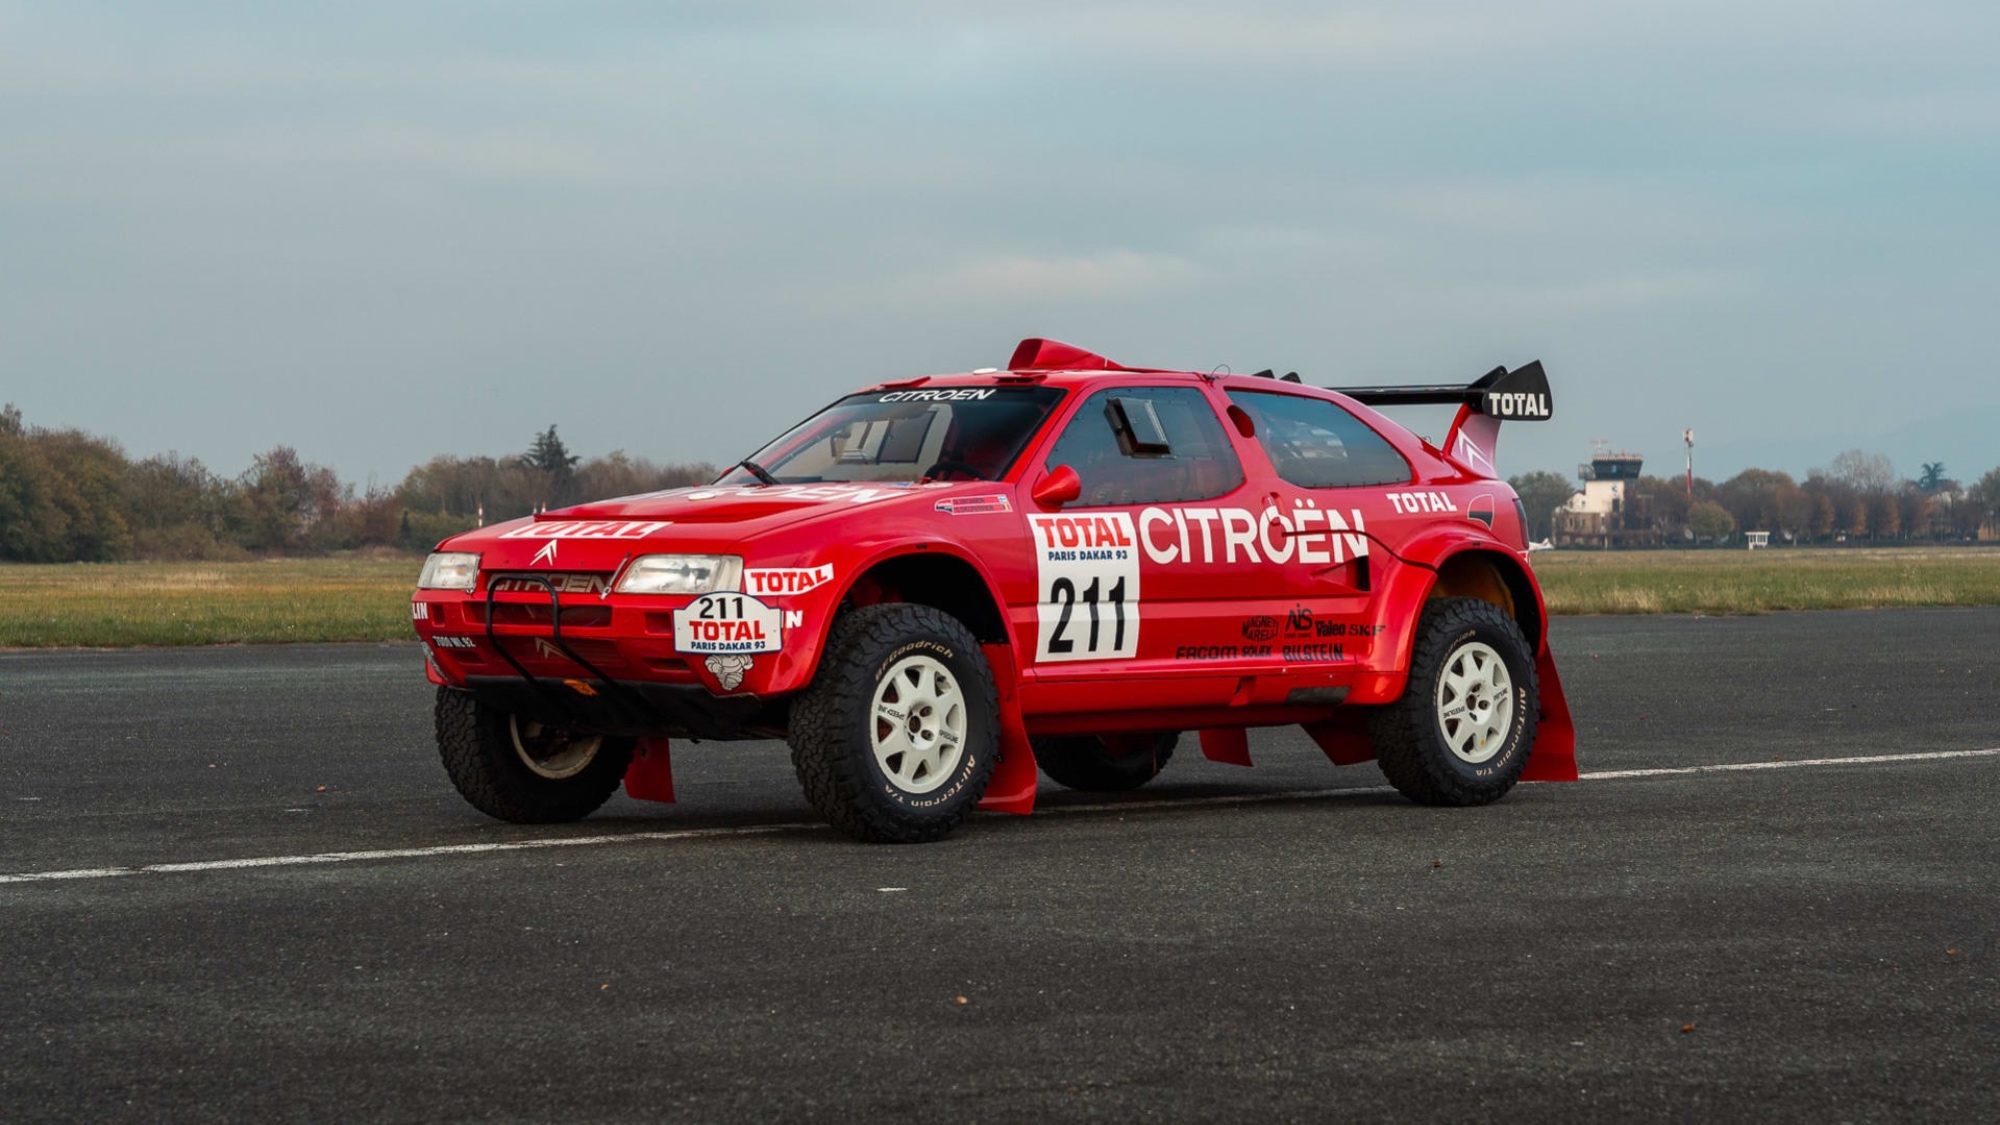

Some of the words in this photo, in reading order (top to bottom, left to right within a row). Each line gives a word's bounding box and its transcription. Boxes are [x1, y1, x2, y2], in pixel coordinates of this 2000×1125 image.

[880, 389, 996, 402] CITROEN
[1488, 393, 1550, 416] TOTAL
[1386, 491, 1458, 514] TOTAL
[513, 520, 648, 536] TOTAL
[1035, 517, 1131, 548] TOTAL
[1138, 498, 1370, 565] CITROËN
[1048, 551, 1077, 561] PARIS
[1080, 550, 1114, 561] DAKAR
[1115, 550, 1128, 560] 93
[750, 569, 828, 593] TOTAL
[699, 597, 744, 619] 211
[1048, 576, 1126, 654] 211
[689, 620, 766, 641] TOTAL
[1348, 625, 1387, 637] SKF
[691, 642, 717, 650] PARIS
[719, 642, 751, 650] DAKAR
[754, 641, 766, 650] 93
[1175, 646, 1238, 660] FACOM
[1282, 643, 1344, 662] BILSTEIN
